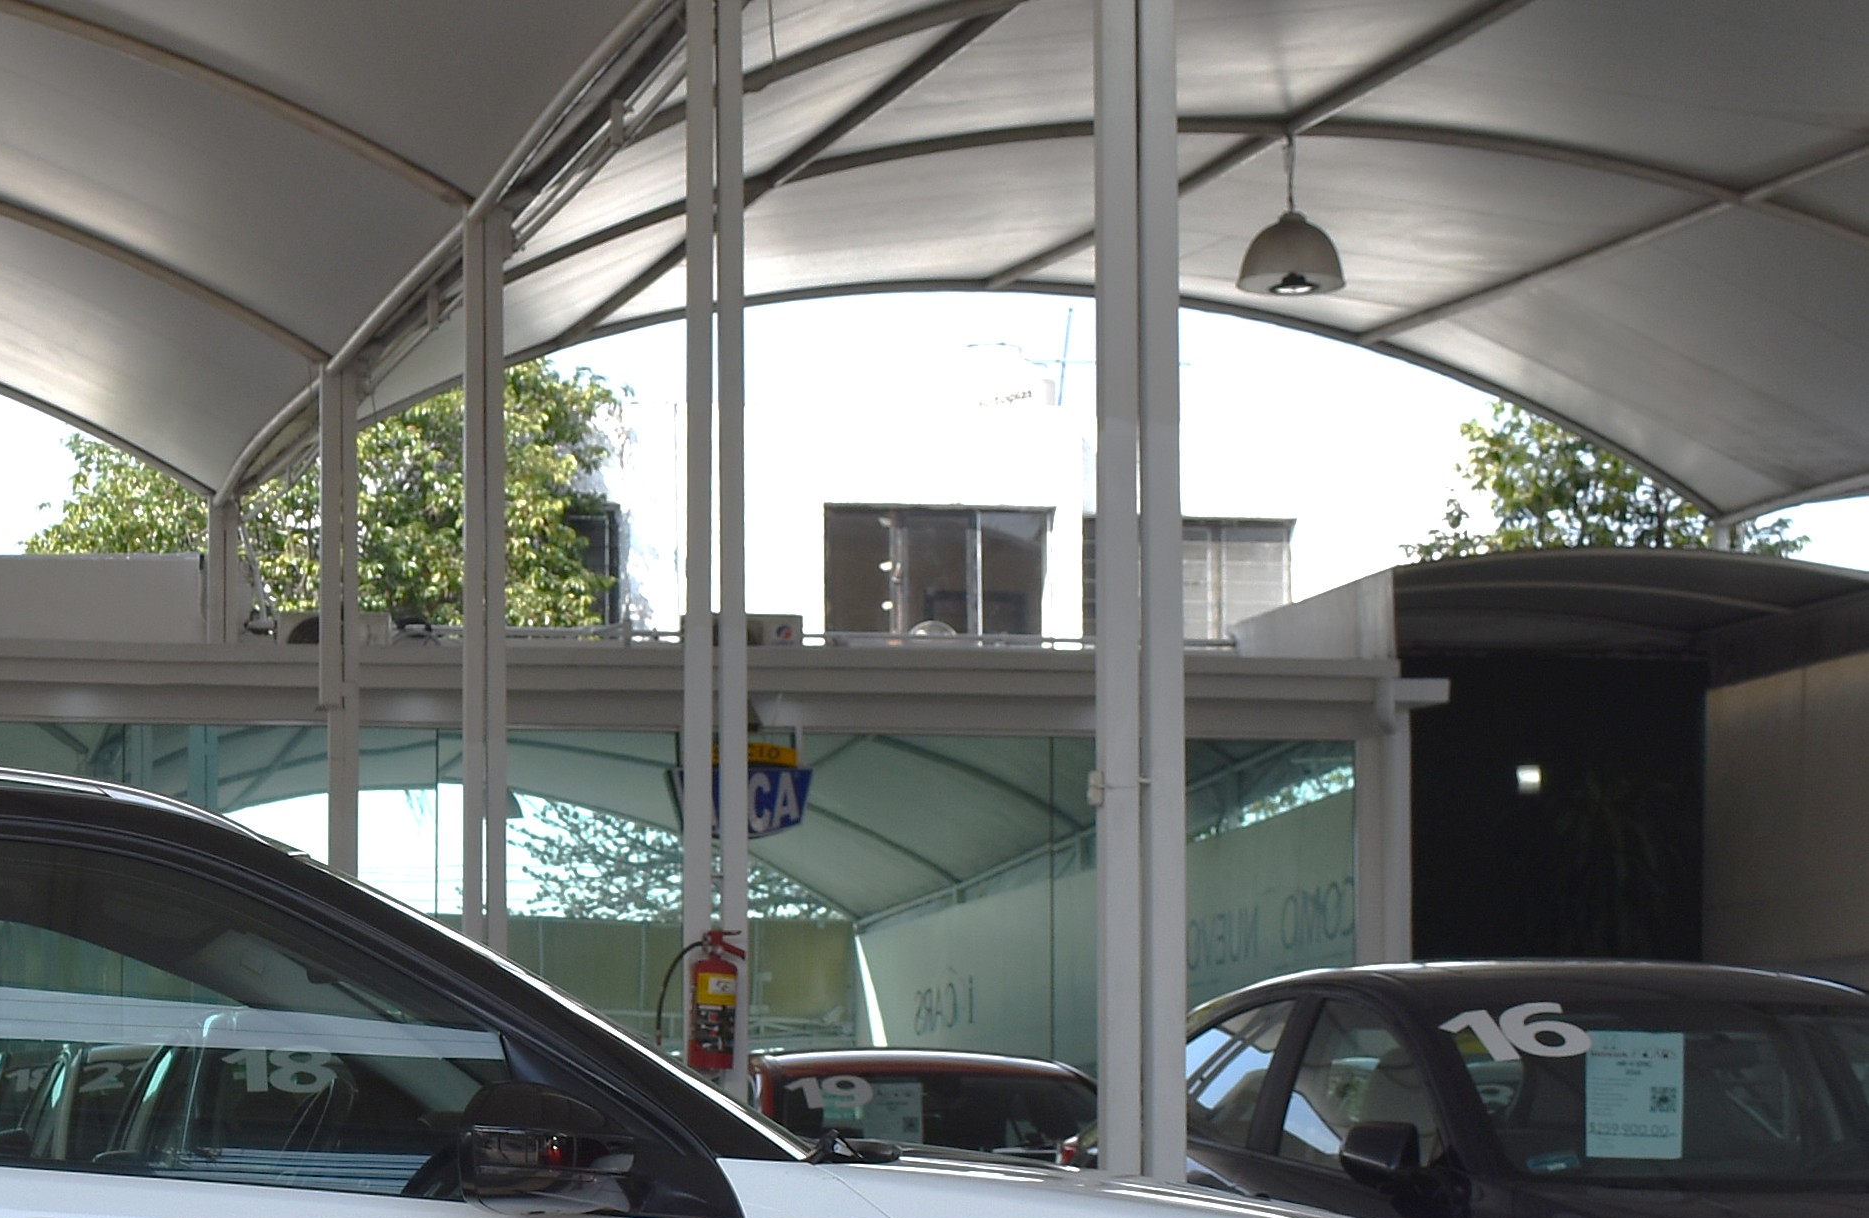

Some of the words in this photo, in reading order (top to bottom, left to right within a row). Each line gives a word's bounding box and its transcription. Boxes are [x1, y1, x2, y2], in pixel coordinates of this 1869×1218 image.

[1438, 1001, 1593, 1062] 16
[221, 1045, 338, 1093] 18
[784, 1074, 874, 1110] 19
